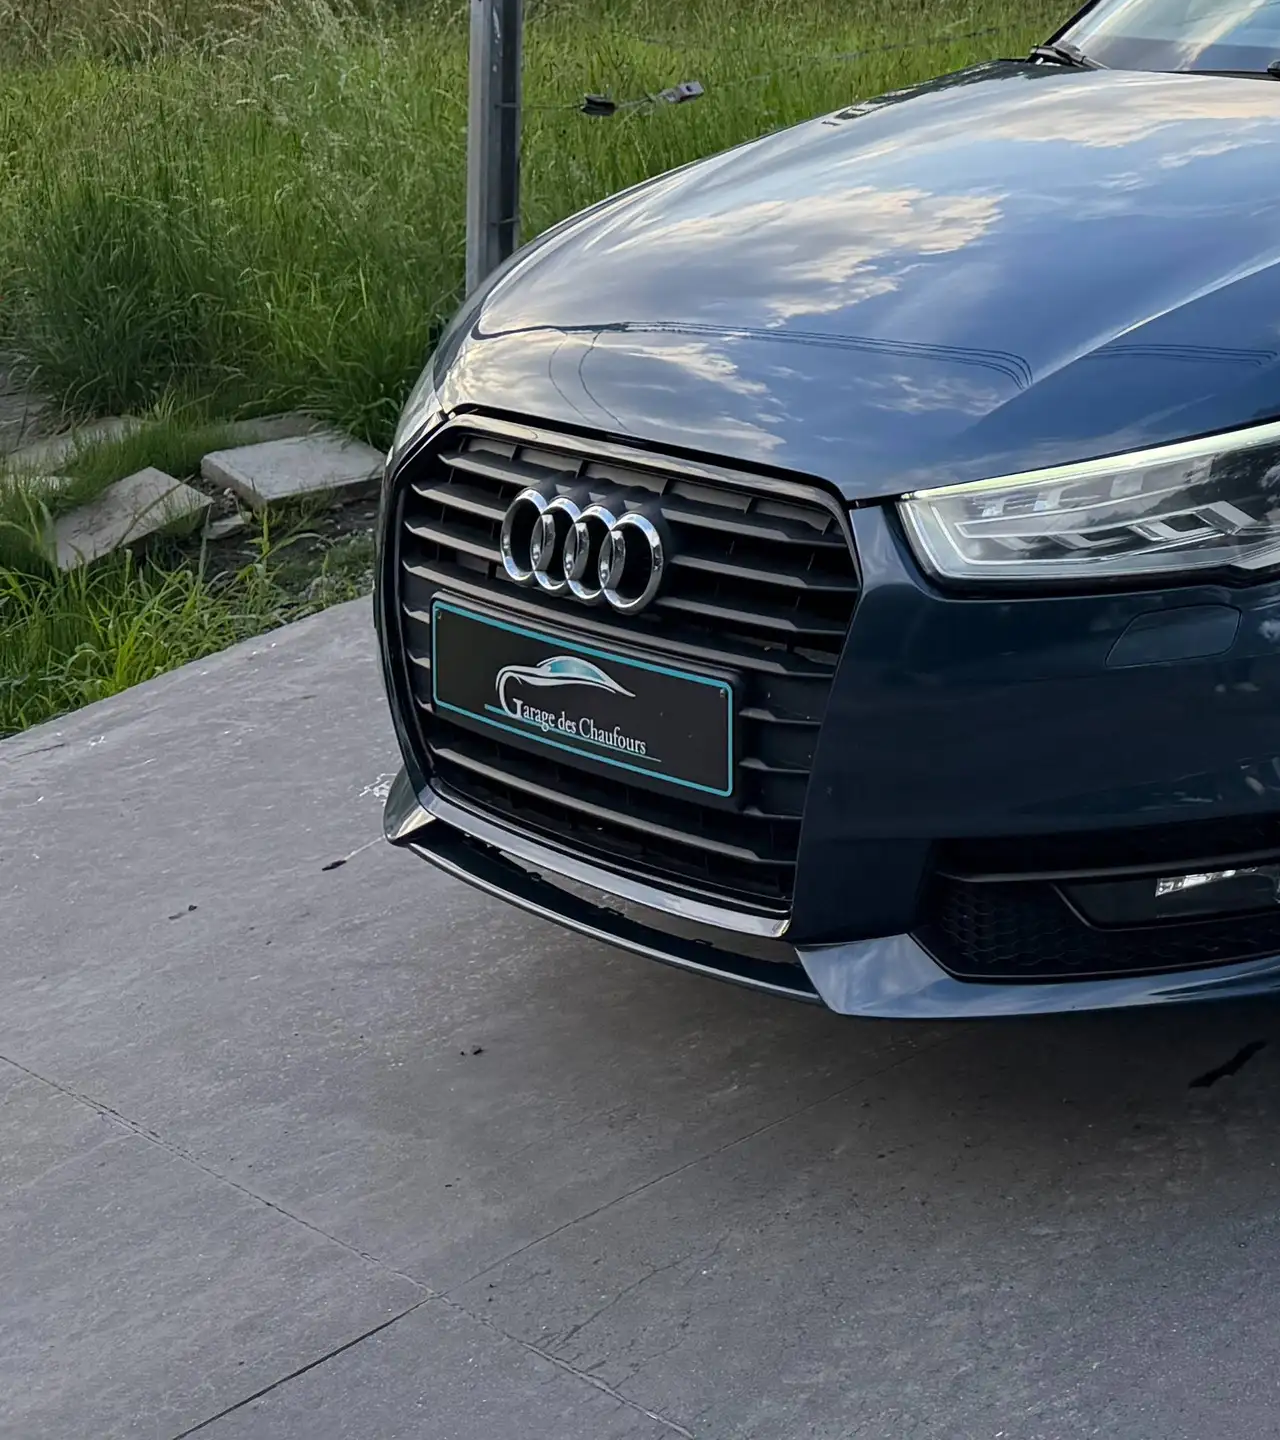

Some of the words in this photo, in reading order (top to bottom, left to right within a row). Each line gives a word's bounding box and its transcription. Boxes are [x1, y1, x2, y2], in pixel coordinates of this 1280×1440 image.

[498, 671, 556, 732] Garage
[557, 711, 577, 734] des
[579, 717, 647, 755] Chaufours
